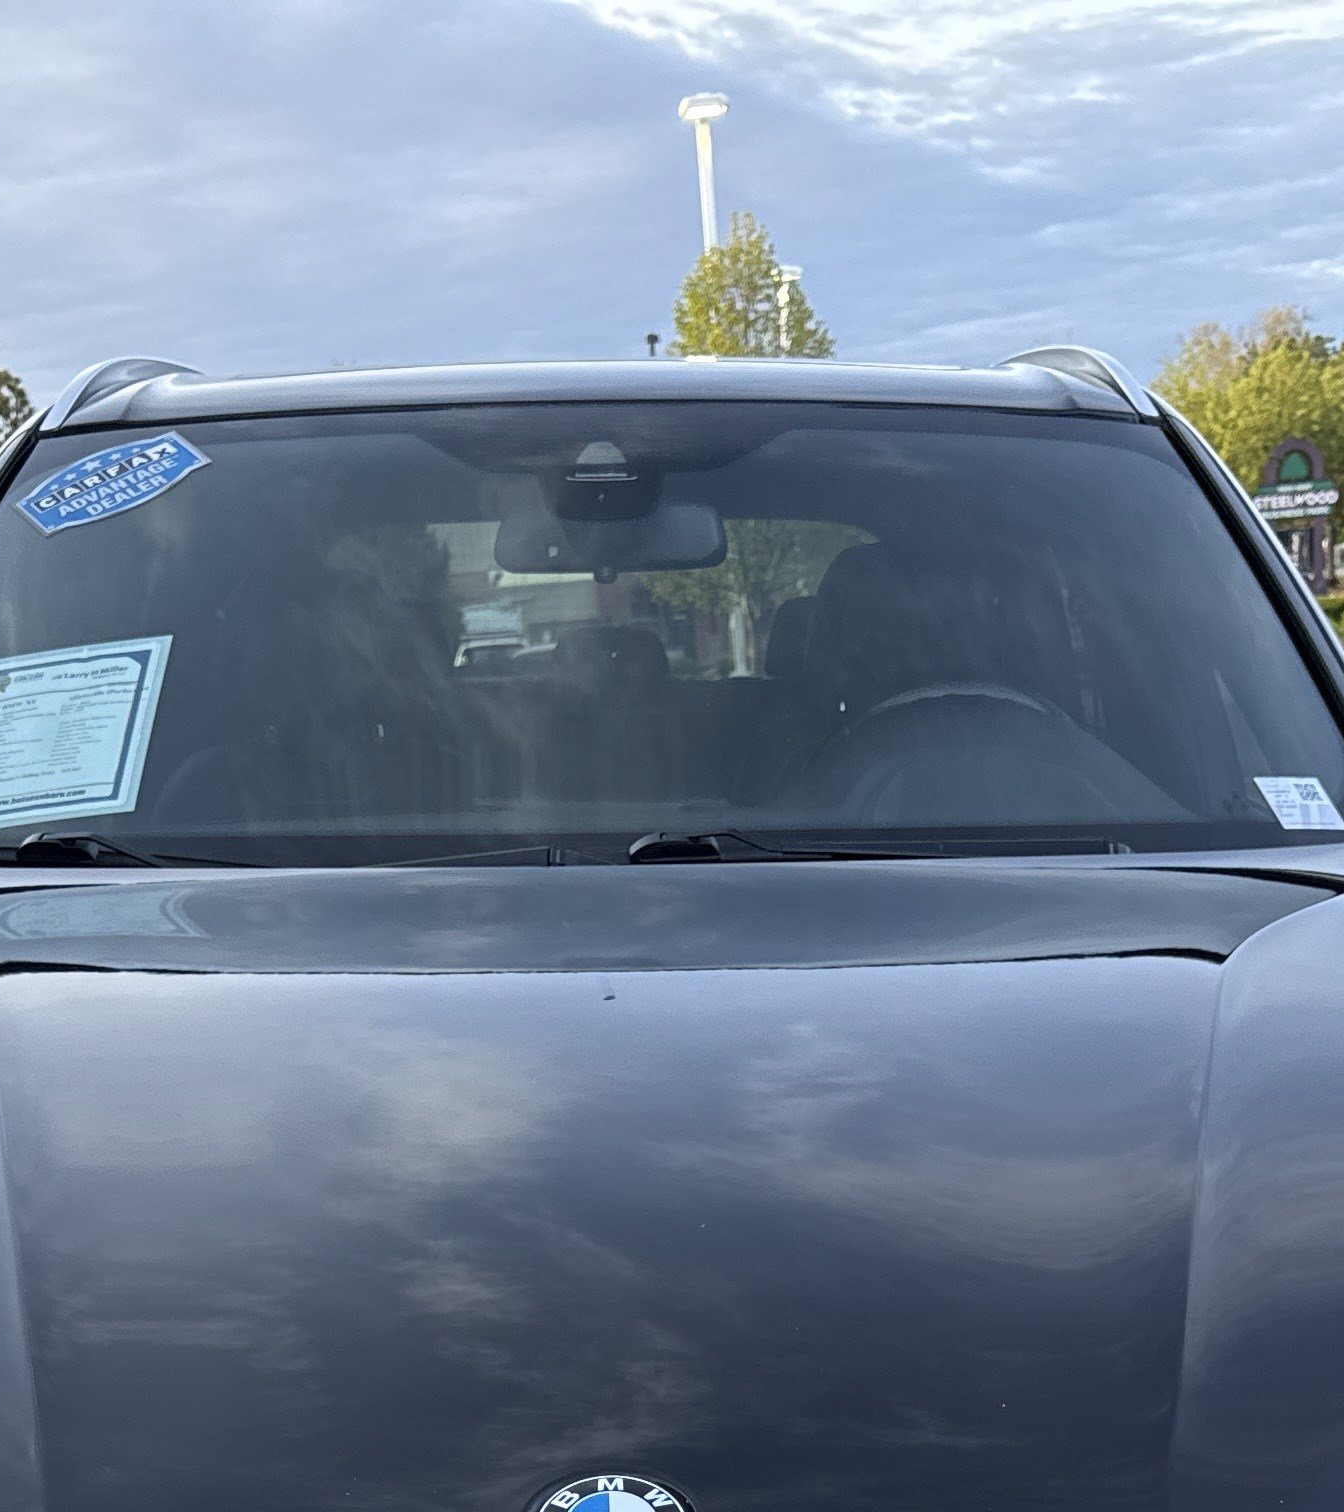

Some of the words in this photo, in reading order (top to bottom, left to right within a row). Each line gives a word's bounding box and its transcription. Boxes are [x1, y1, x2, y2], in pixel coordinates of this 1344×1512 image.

[37, 443, 178, 511] CARFAX
[59, 455, 179, 517] ADVANTAGE
[85, 475, 168, 516] DEALER
[551, 1477, 674, 1510] BMW
